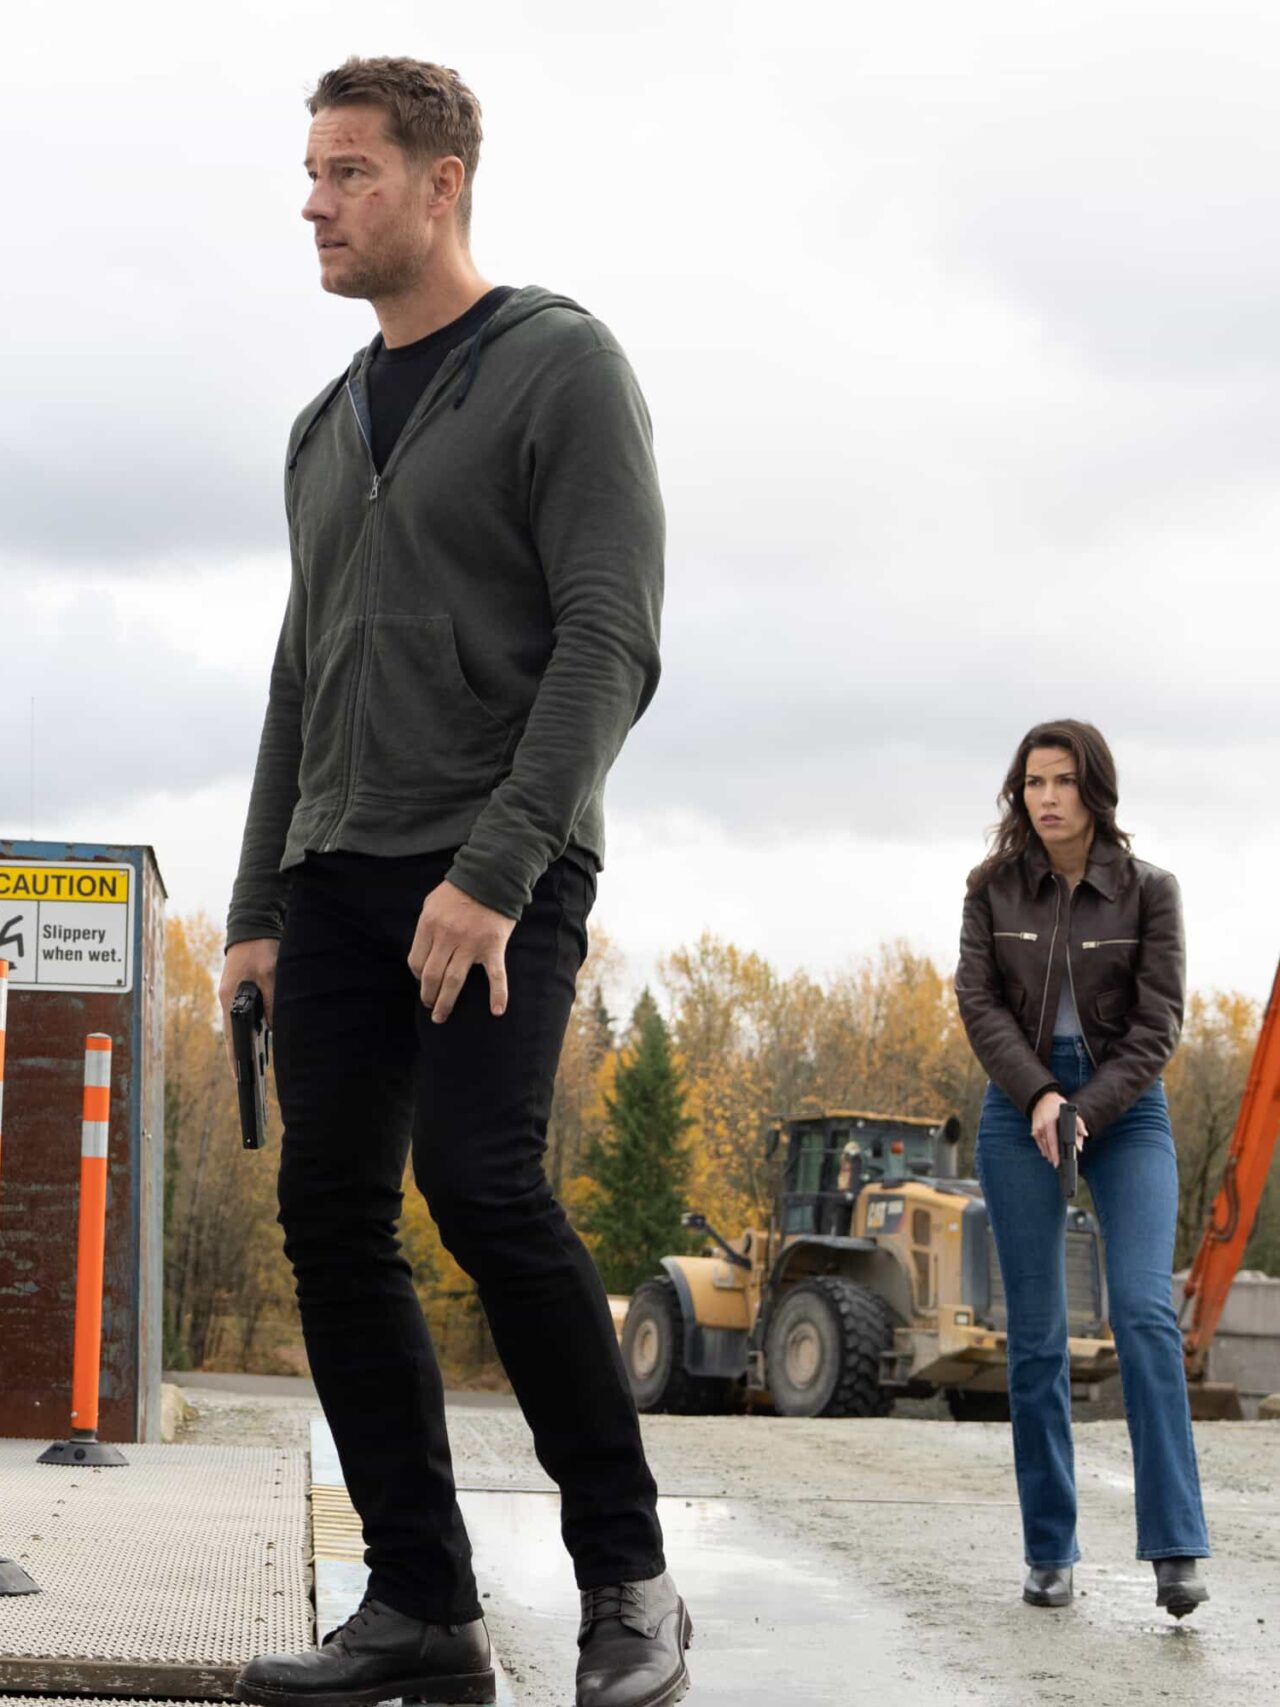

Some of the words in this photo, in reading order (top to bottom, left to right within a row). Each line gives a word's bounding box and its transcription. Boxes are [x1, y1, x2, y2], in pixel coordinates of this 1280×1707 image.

[43, 924, 106, 943] Slippery
[43, 947, 82, 961] when
[89, 950, 122, 962] wet.
